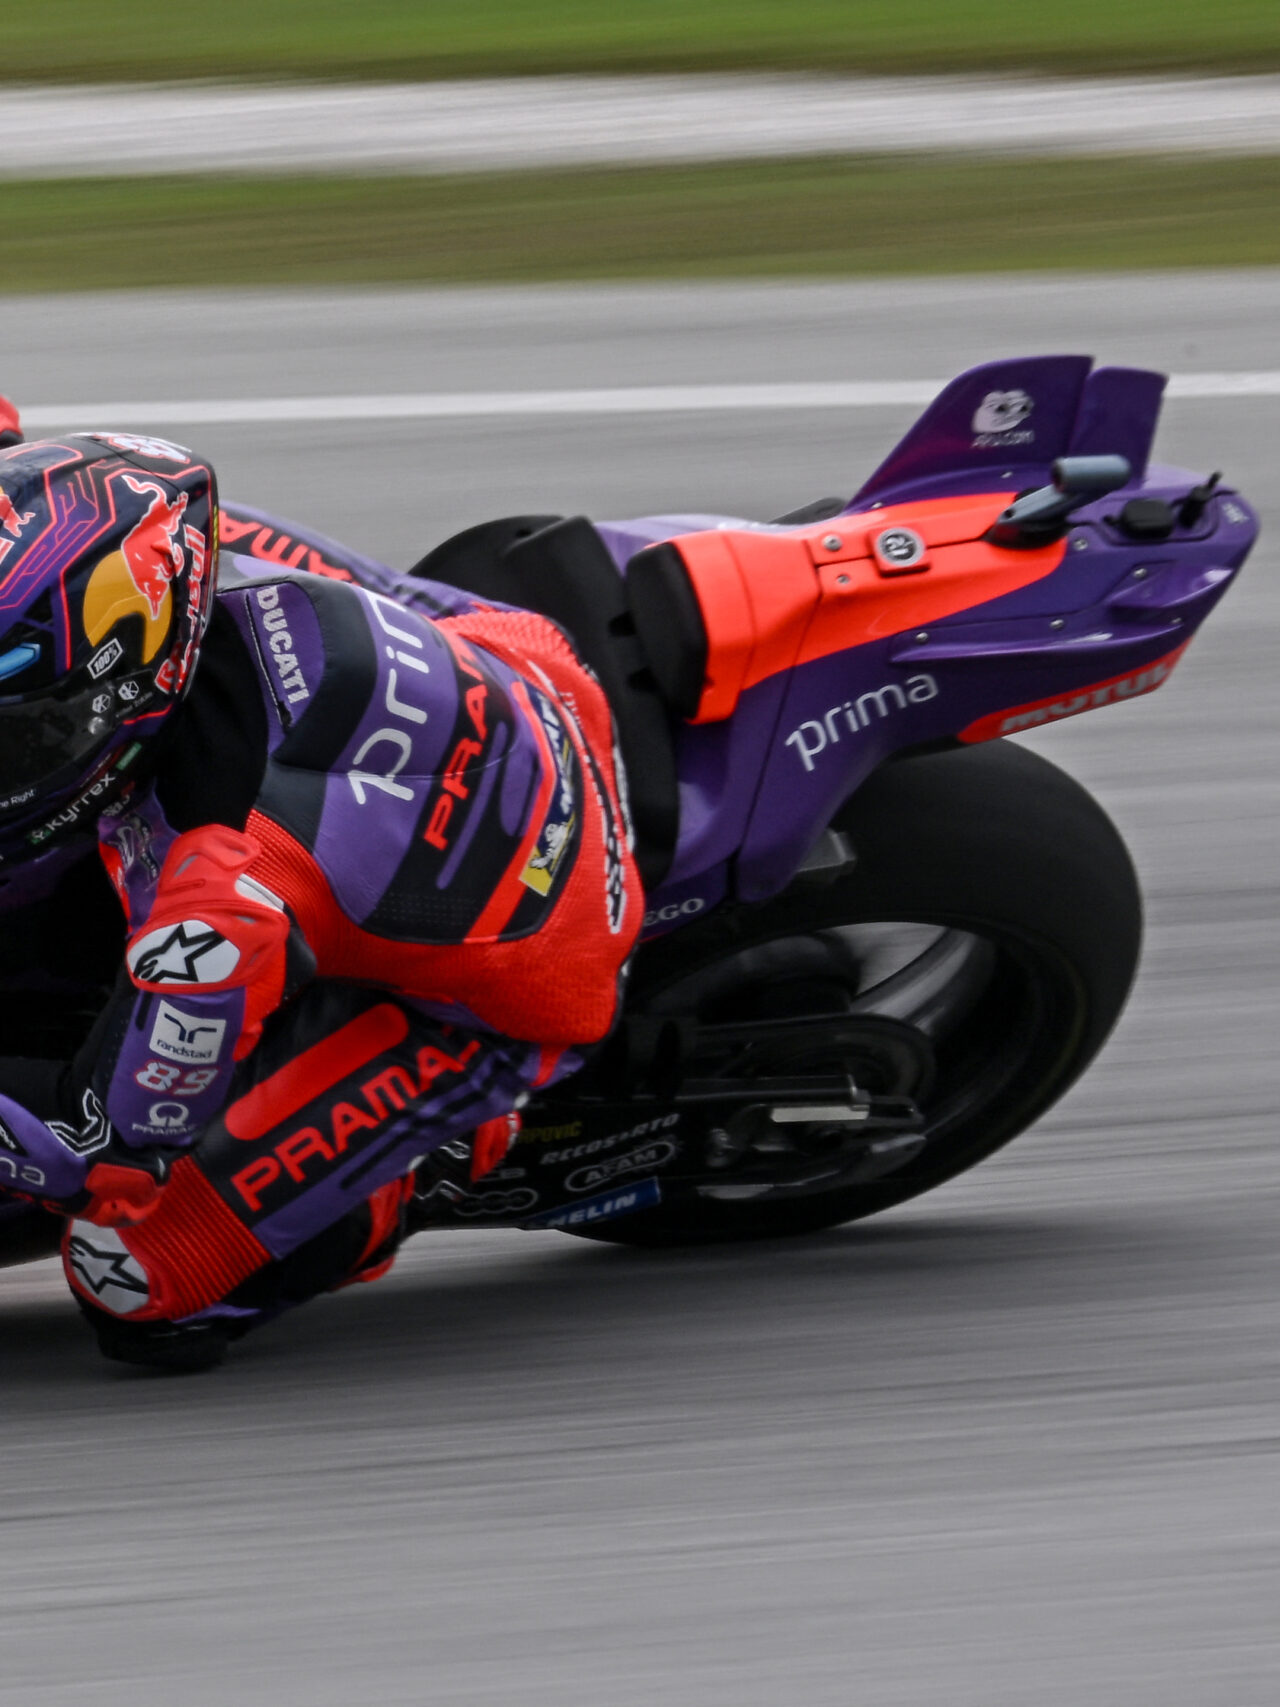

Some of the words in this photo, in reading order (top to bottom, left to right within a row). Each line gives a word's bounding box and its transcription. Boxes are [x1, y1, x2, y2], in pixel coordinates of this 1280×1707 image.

[256, 584, 311, 705] DUCATI
[347, 590, 430, 805] prim
[785, 672, 940, 772] prima
[998, 663, 1169, 733] MOTUL
[11, 788, 37, 808] Right
[46, 771, 117, 832] kyrrex
[134, 1058, 220, 1097] 89
[155, 1037, 214, 1060] randstad
